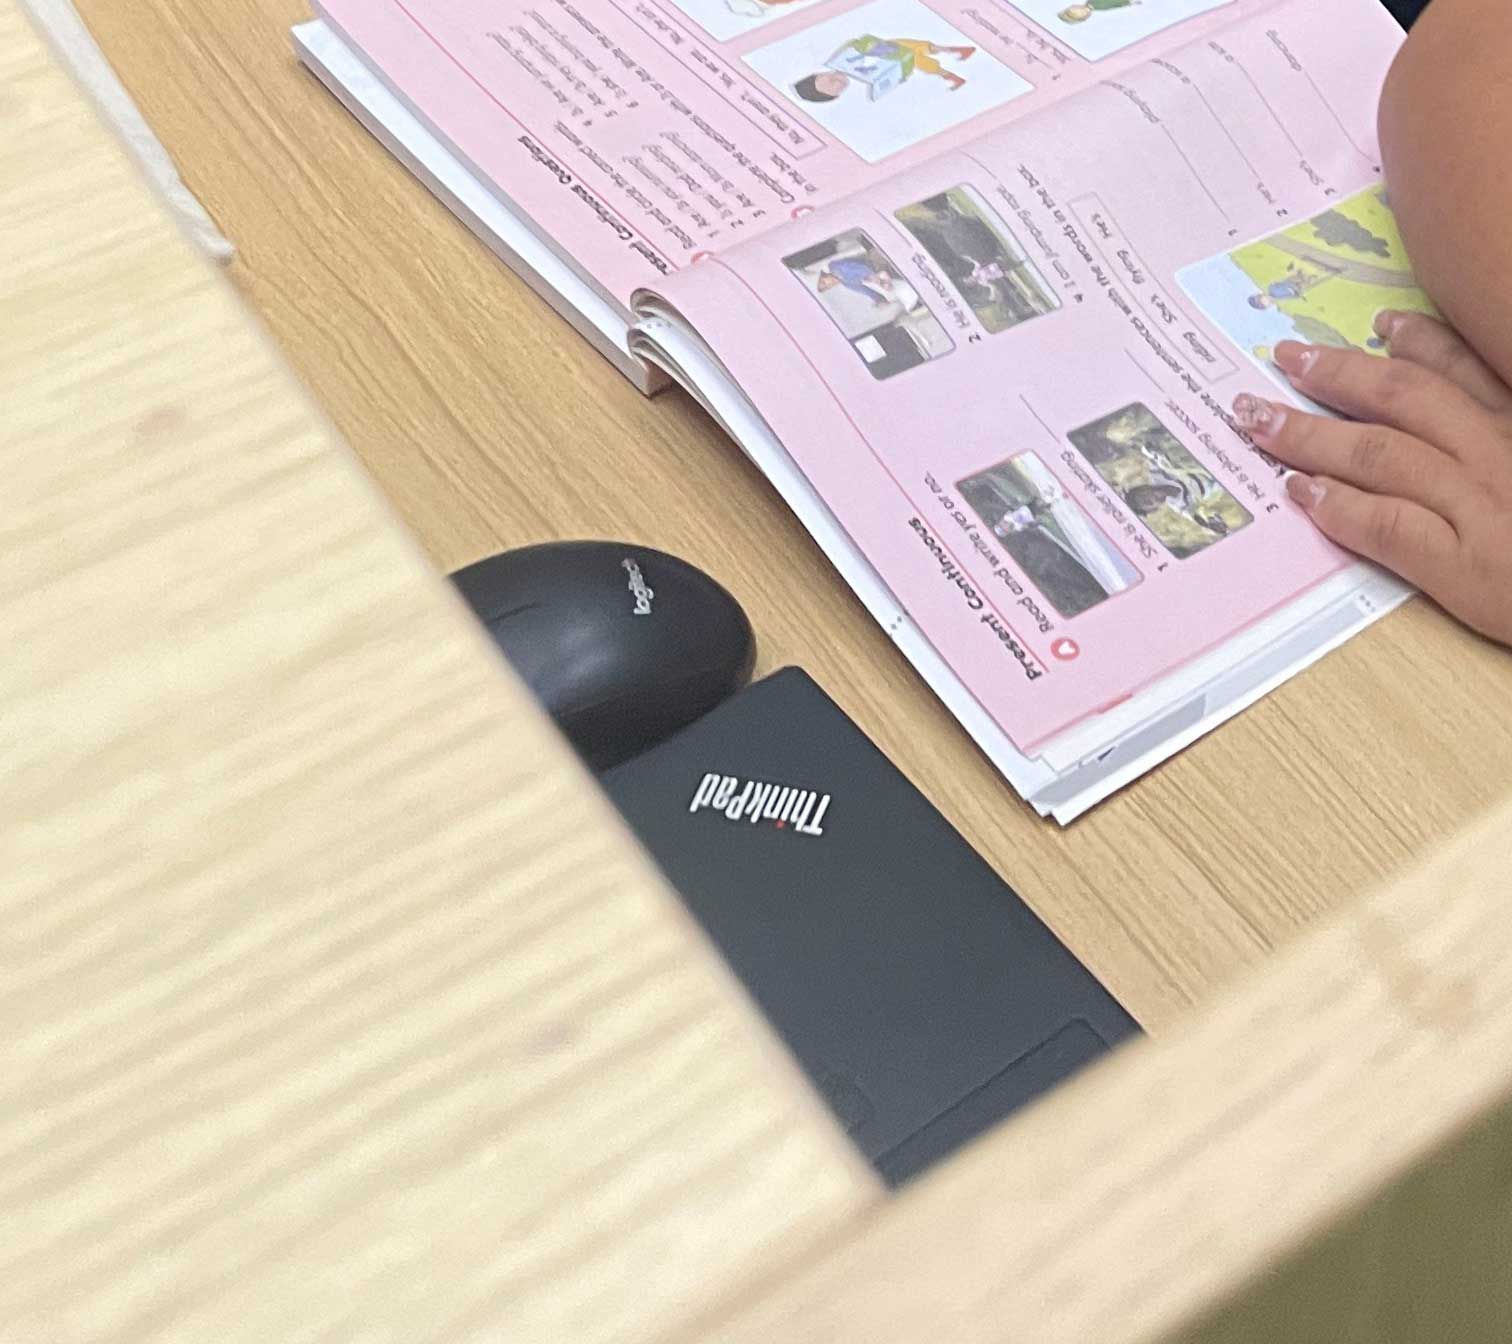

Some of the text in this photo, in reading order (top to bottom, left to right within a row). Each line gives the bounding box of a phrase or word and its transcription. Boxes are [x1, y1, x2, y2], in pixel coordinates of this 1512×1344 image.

[515, 132, 672, 277] resent Continuous Questions
[1033, 185, 1056, 211] the
[1048, 207, 1066, 225] in
[1014, 206, 1060, 262] jumping
[1059, 222, 1095, 266] words
[1050, 257, 1070, 281] am
[1087, 262, 1111, 289] the
[949, 308, 970, 331] He
[1104, 286, 1133, 318] with
[1146, 292, 1178, 327] She's
[1128, 314, 1184, 376] sentences
[1180, 328, 1217, 367] riding
[1177, 370, 1202, 396] the
[1193, 429, 1242, 477] playing
[919, 469, 944, 497] no.
[936, 491, 955, 511] or
[1092, 490, 1128, 528] roller
[949, 504, 977, 535] yes
[964, 529, 1001, 571] write
[1129, 531, 1158, 561] She
[902, 514, 1043, 685] Present Continuous
[991, 564, 1025, 600] and
[1015, 592, 1055, 637] Read
[689, 773, 831, 836] ThinkPad
